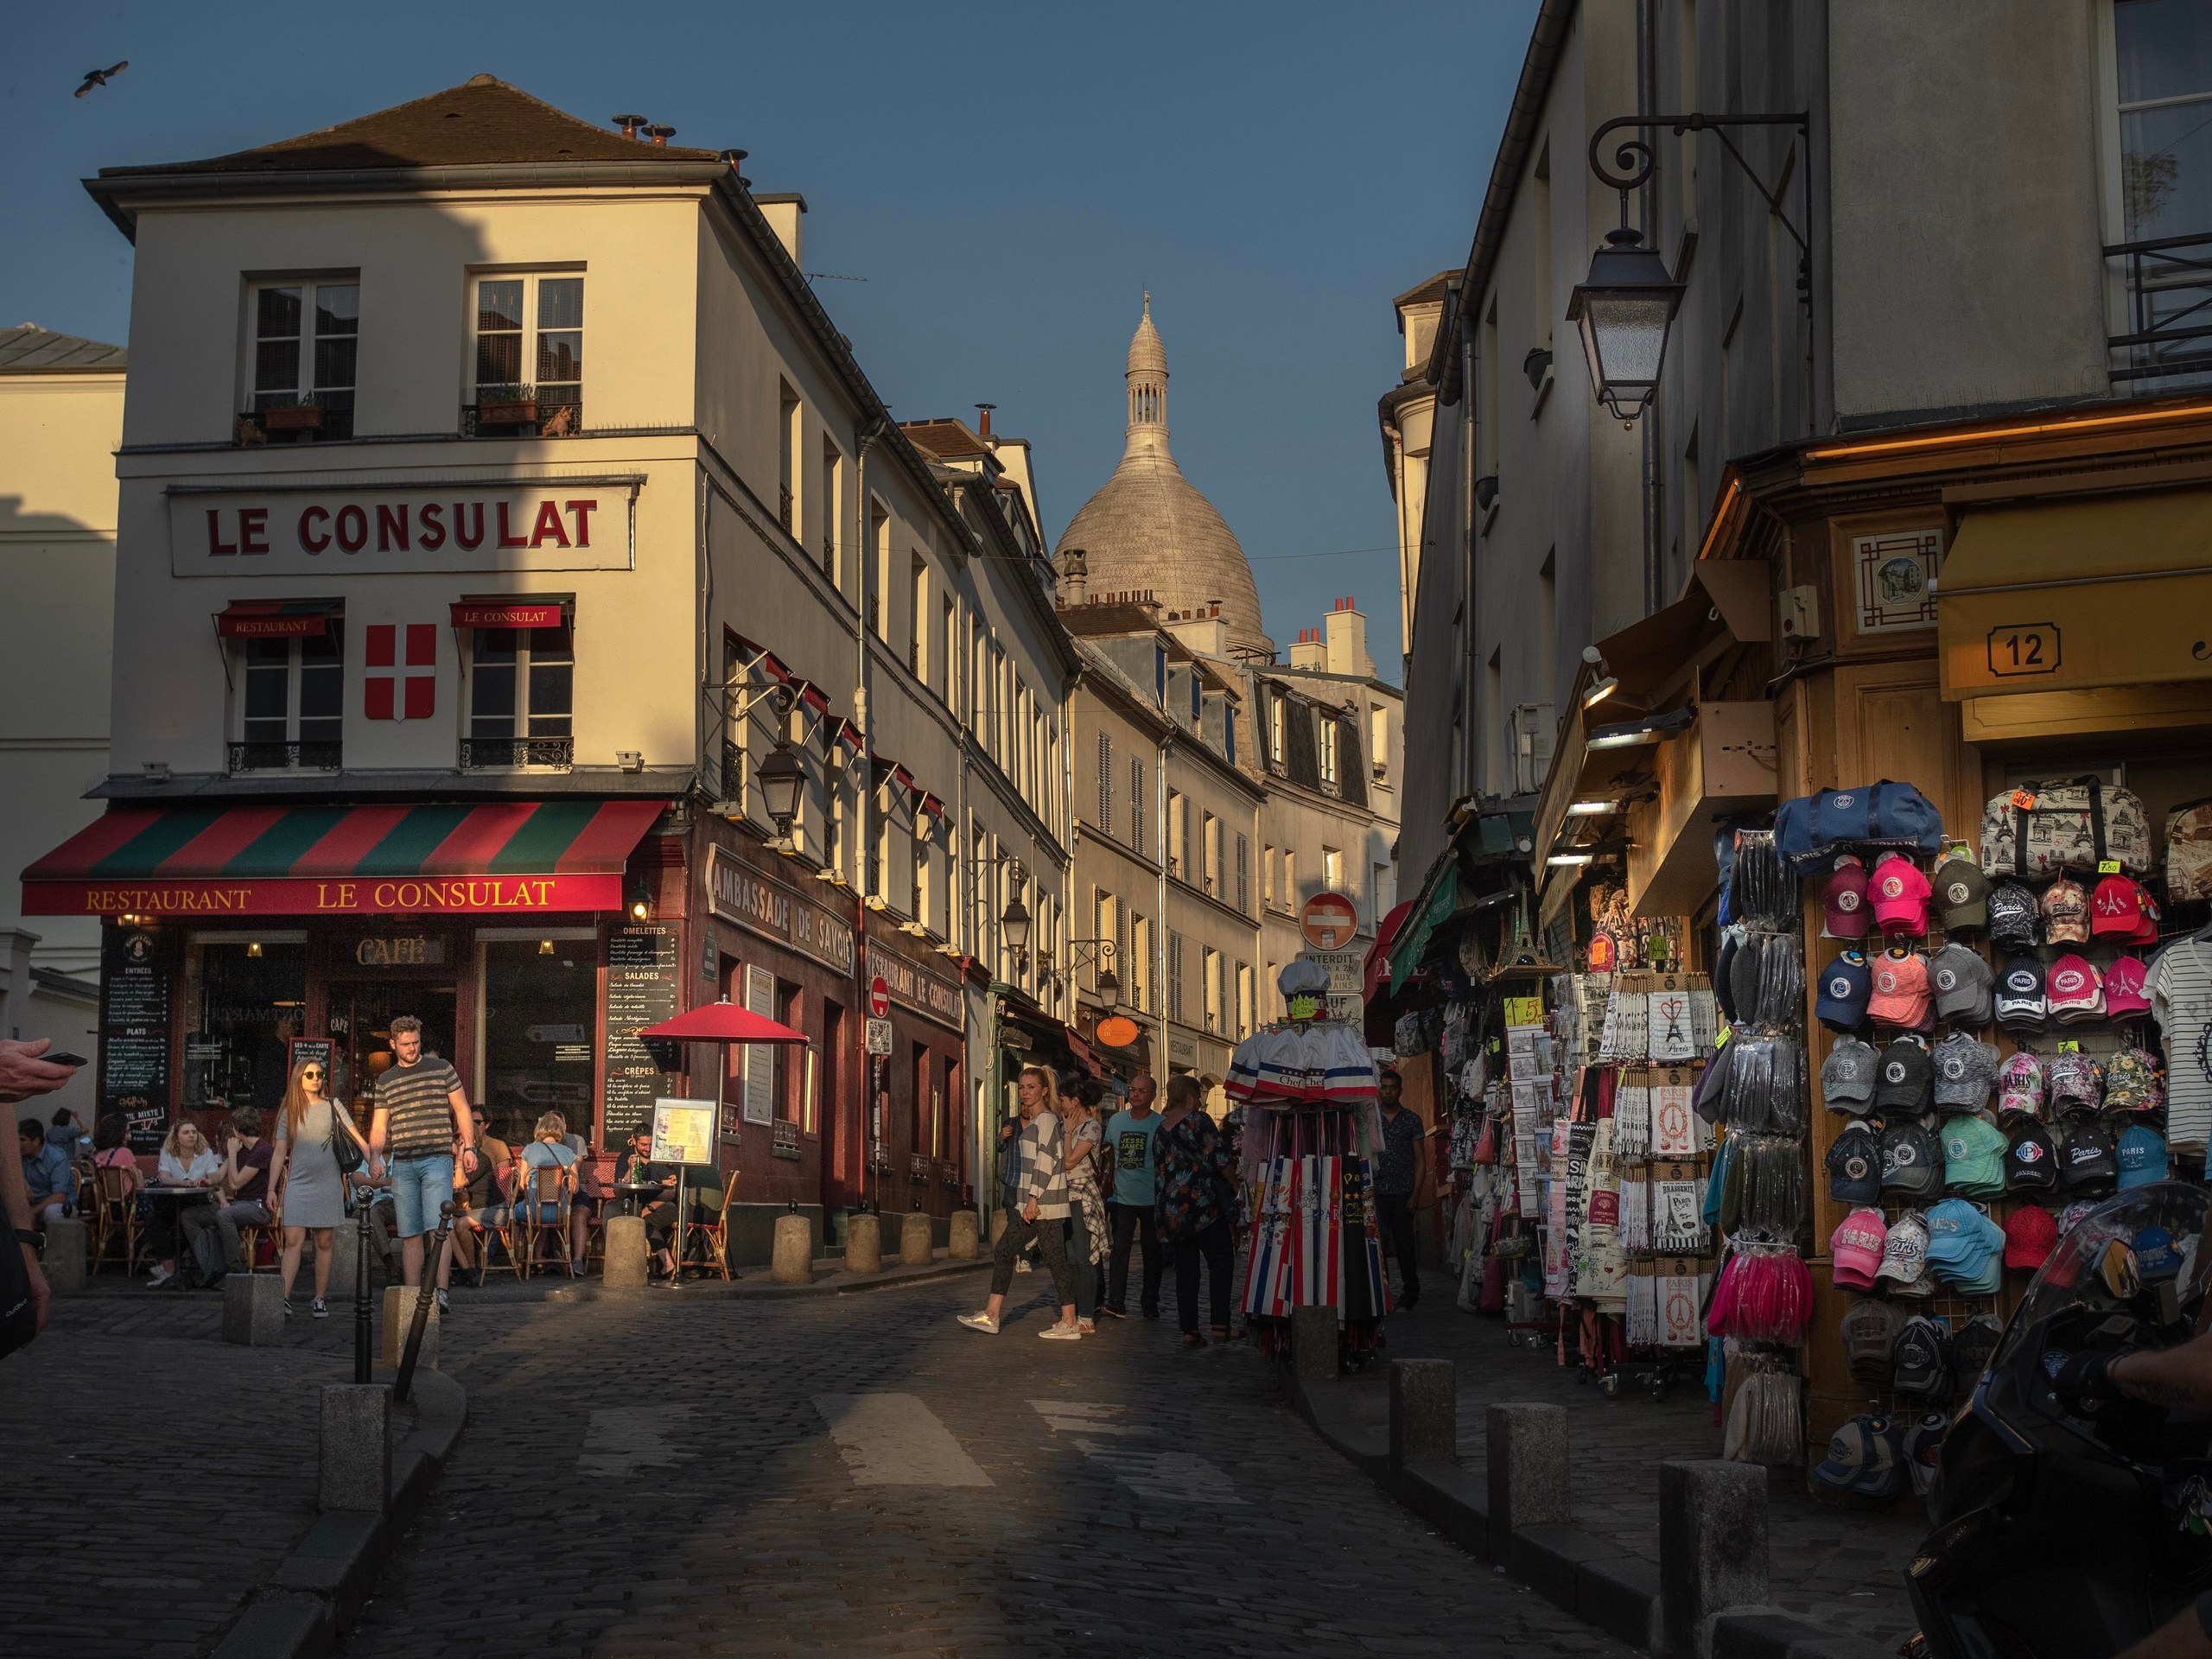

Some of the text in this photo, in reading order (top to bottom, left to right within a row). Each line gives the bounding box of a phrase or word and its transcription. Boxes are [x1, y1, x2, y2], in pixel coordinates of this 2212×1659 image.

[206, 499, 598, 556] LE CONSULAT
[465, 611, 547, 622] LE CONSULAT
[236, 620, 309, 632] RESTAURANT
[2006, 633, 2043, 666] 12
[86, 880, 556, 912] RESTAURANT LE CONSULAT
[1994, 901, 2024, 912] Paris
[2052, 904, 2082, 913] Paris
[714, 862, 852, 964] AMBASSADE DE SAVOIE
[623, 926, 666, 935] OMELETTES
[355, 934, 426, 966] CAFÉ
[2012, 976, 2033, 985] PARIS
[2060, 976, 2079, 986] PARIS
[918, 976, 926, 1004] LE
[330, 1016, 349, 1035] CAFÉ
[1666, 1042, 1691, 1054] Paris
[624, 1066, 655, 1075] CRÊPES
[2107, 1071, 2131, 1082] Paris
[1279, 1076, 1302, 1088] Chef
[1305, 1077, 1325, 1087] Chef
[2003, 1073, 2031, 1089] PARIS
[1660, 1088, 1688, 1097] PARIS
[2070, 1147, 2101, 1159] Paris
[2121, 1147, 2145, 1157] PARIS
[1662, 1185, 1694, 1194] BRASSERIE
[1841, 1229, 1882, 1252] PARIS
[1885, 1236, 1917, 1255] Paris
[1666, 1279, 1694, 1288] PARIS
